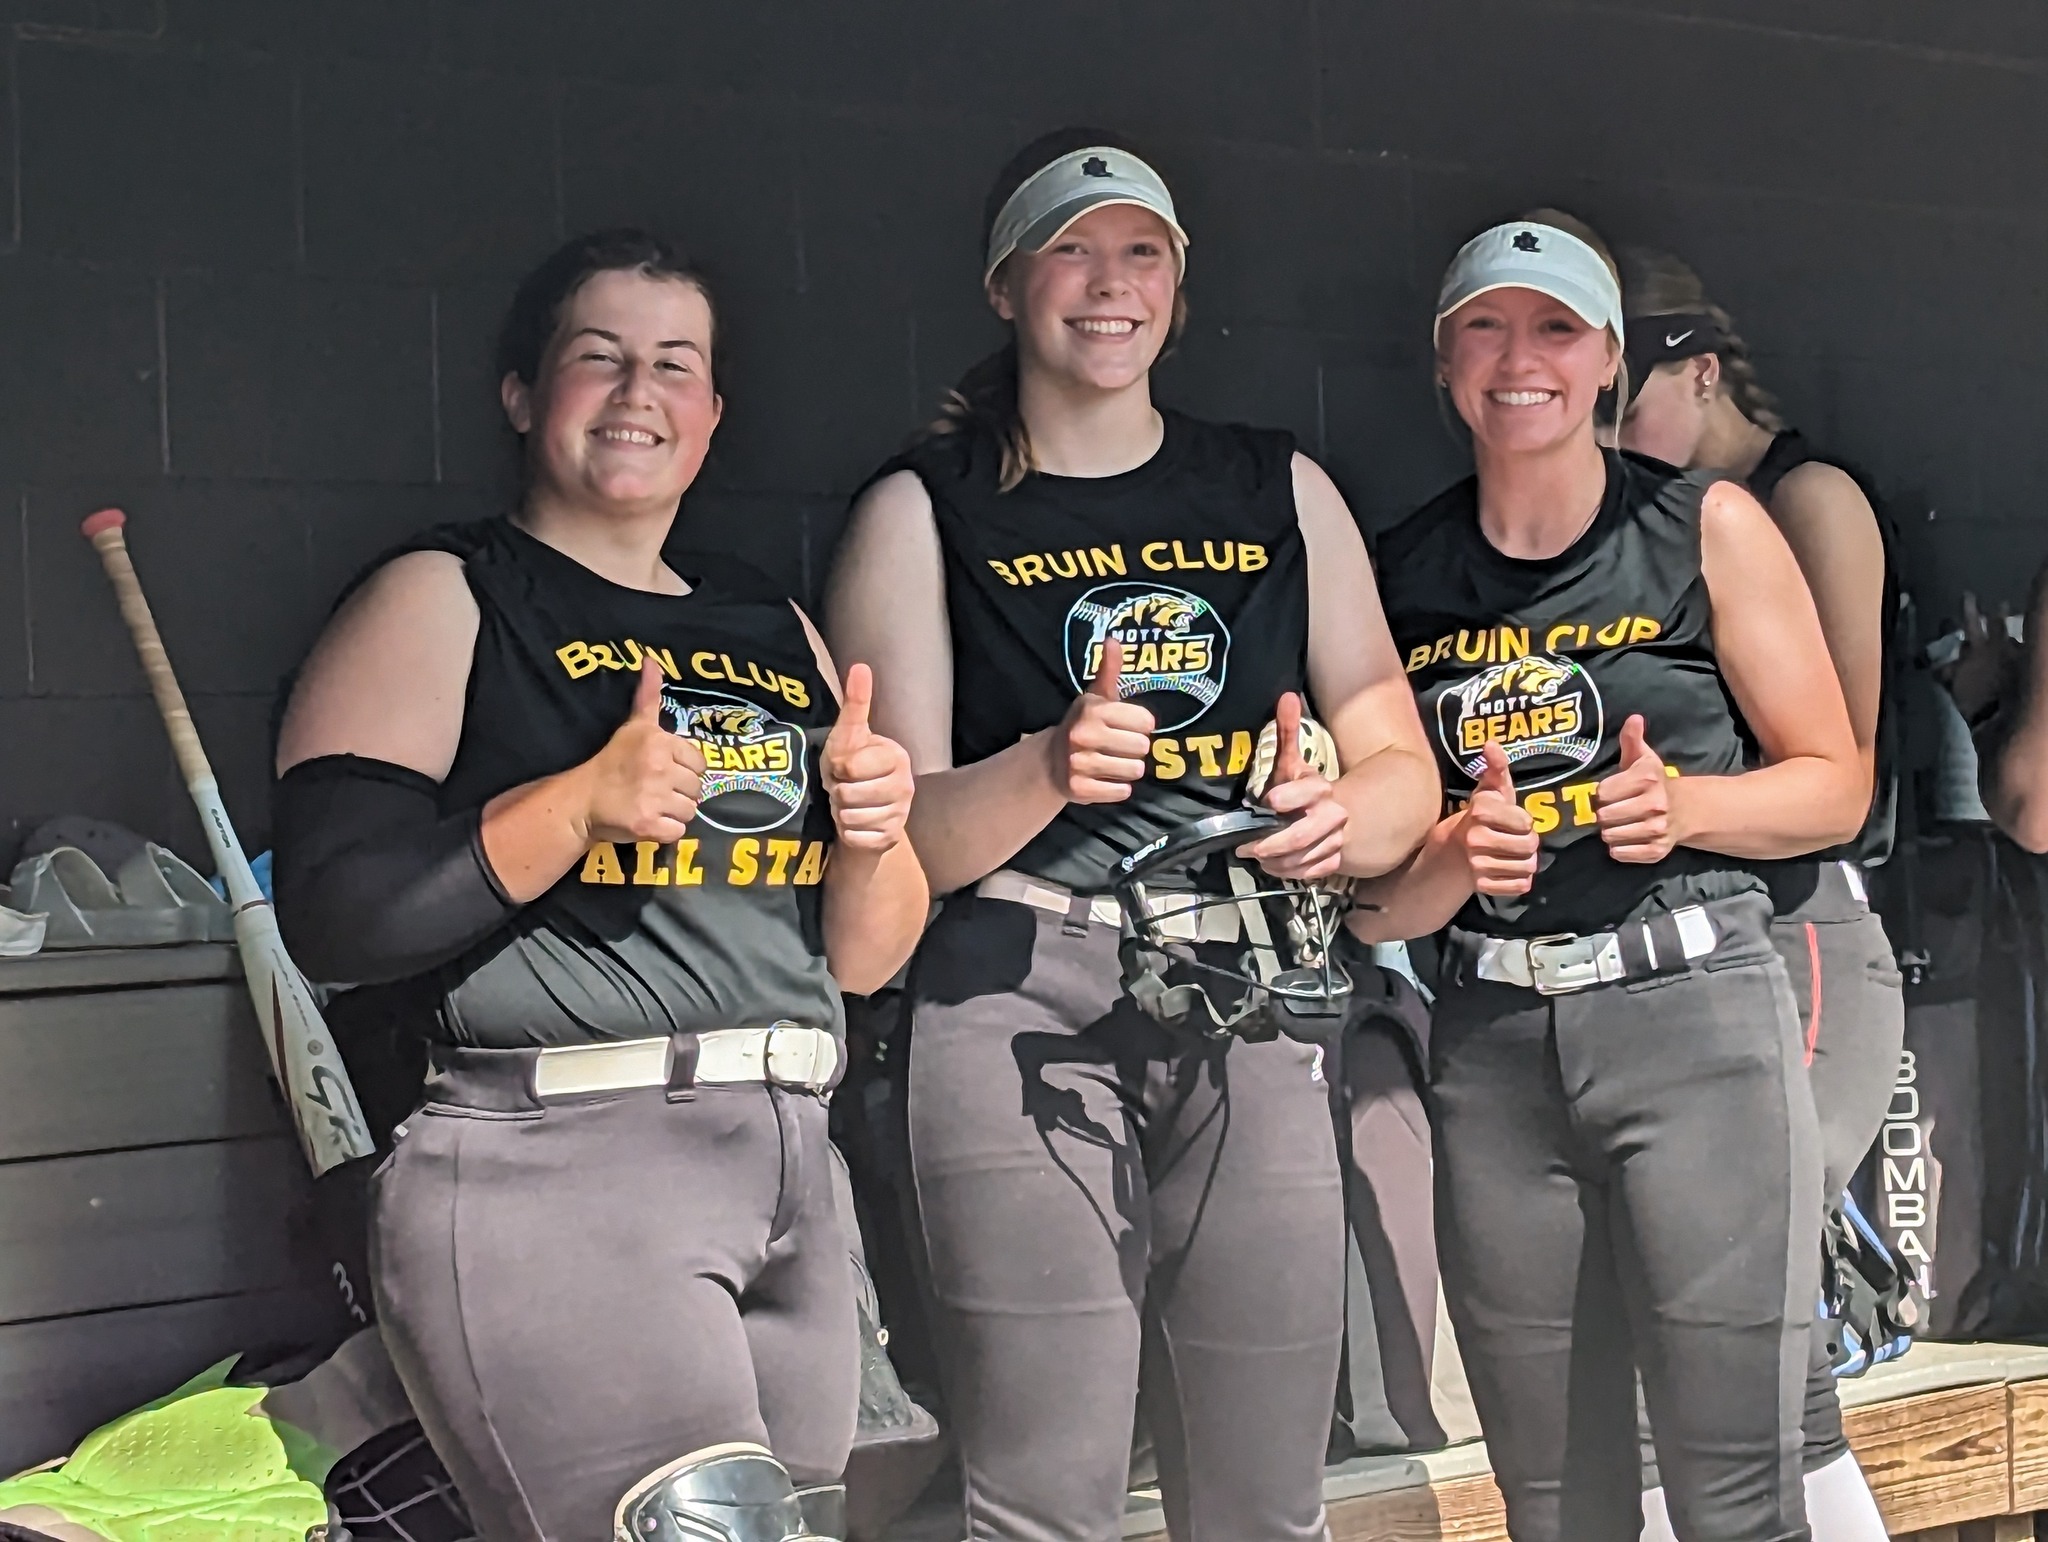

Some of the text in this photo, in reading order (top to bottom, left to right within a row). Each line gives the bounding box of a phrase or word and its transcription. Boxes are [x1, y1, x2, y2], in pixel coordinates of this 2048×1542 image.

[987, 540, 1269, 586] BRUIN CLUB
[556, 638, 811, 708] BRUN CLUB
[1406, 626, 1530, 673] BRUIN
[1463, 702, 1577, 748] BEARS
[690, 738, 788, 770] EARS
[1152, 731, 1252, 780] STA
[580, 838, 703, 885] ALL
